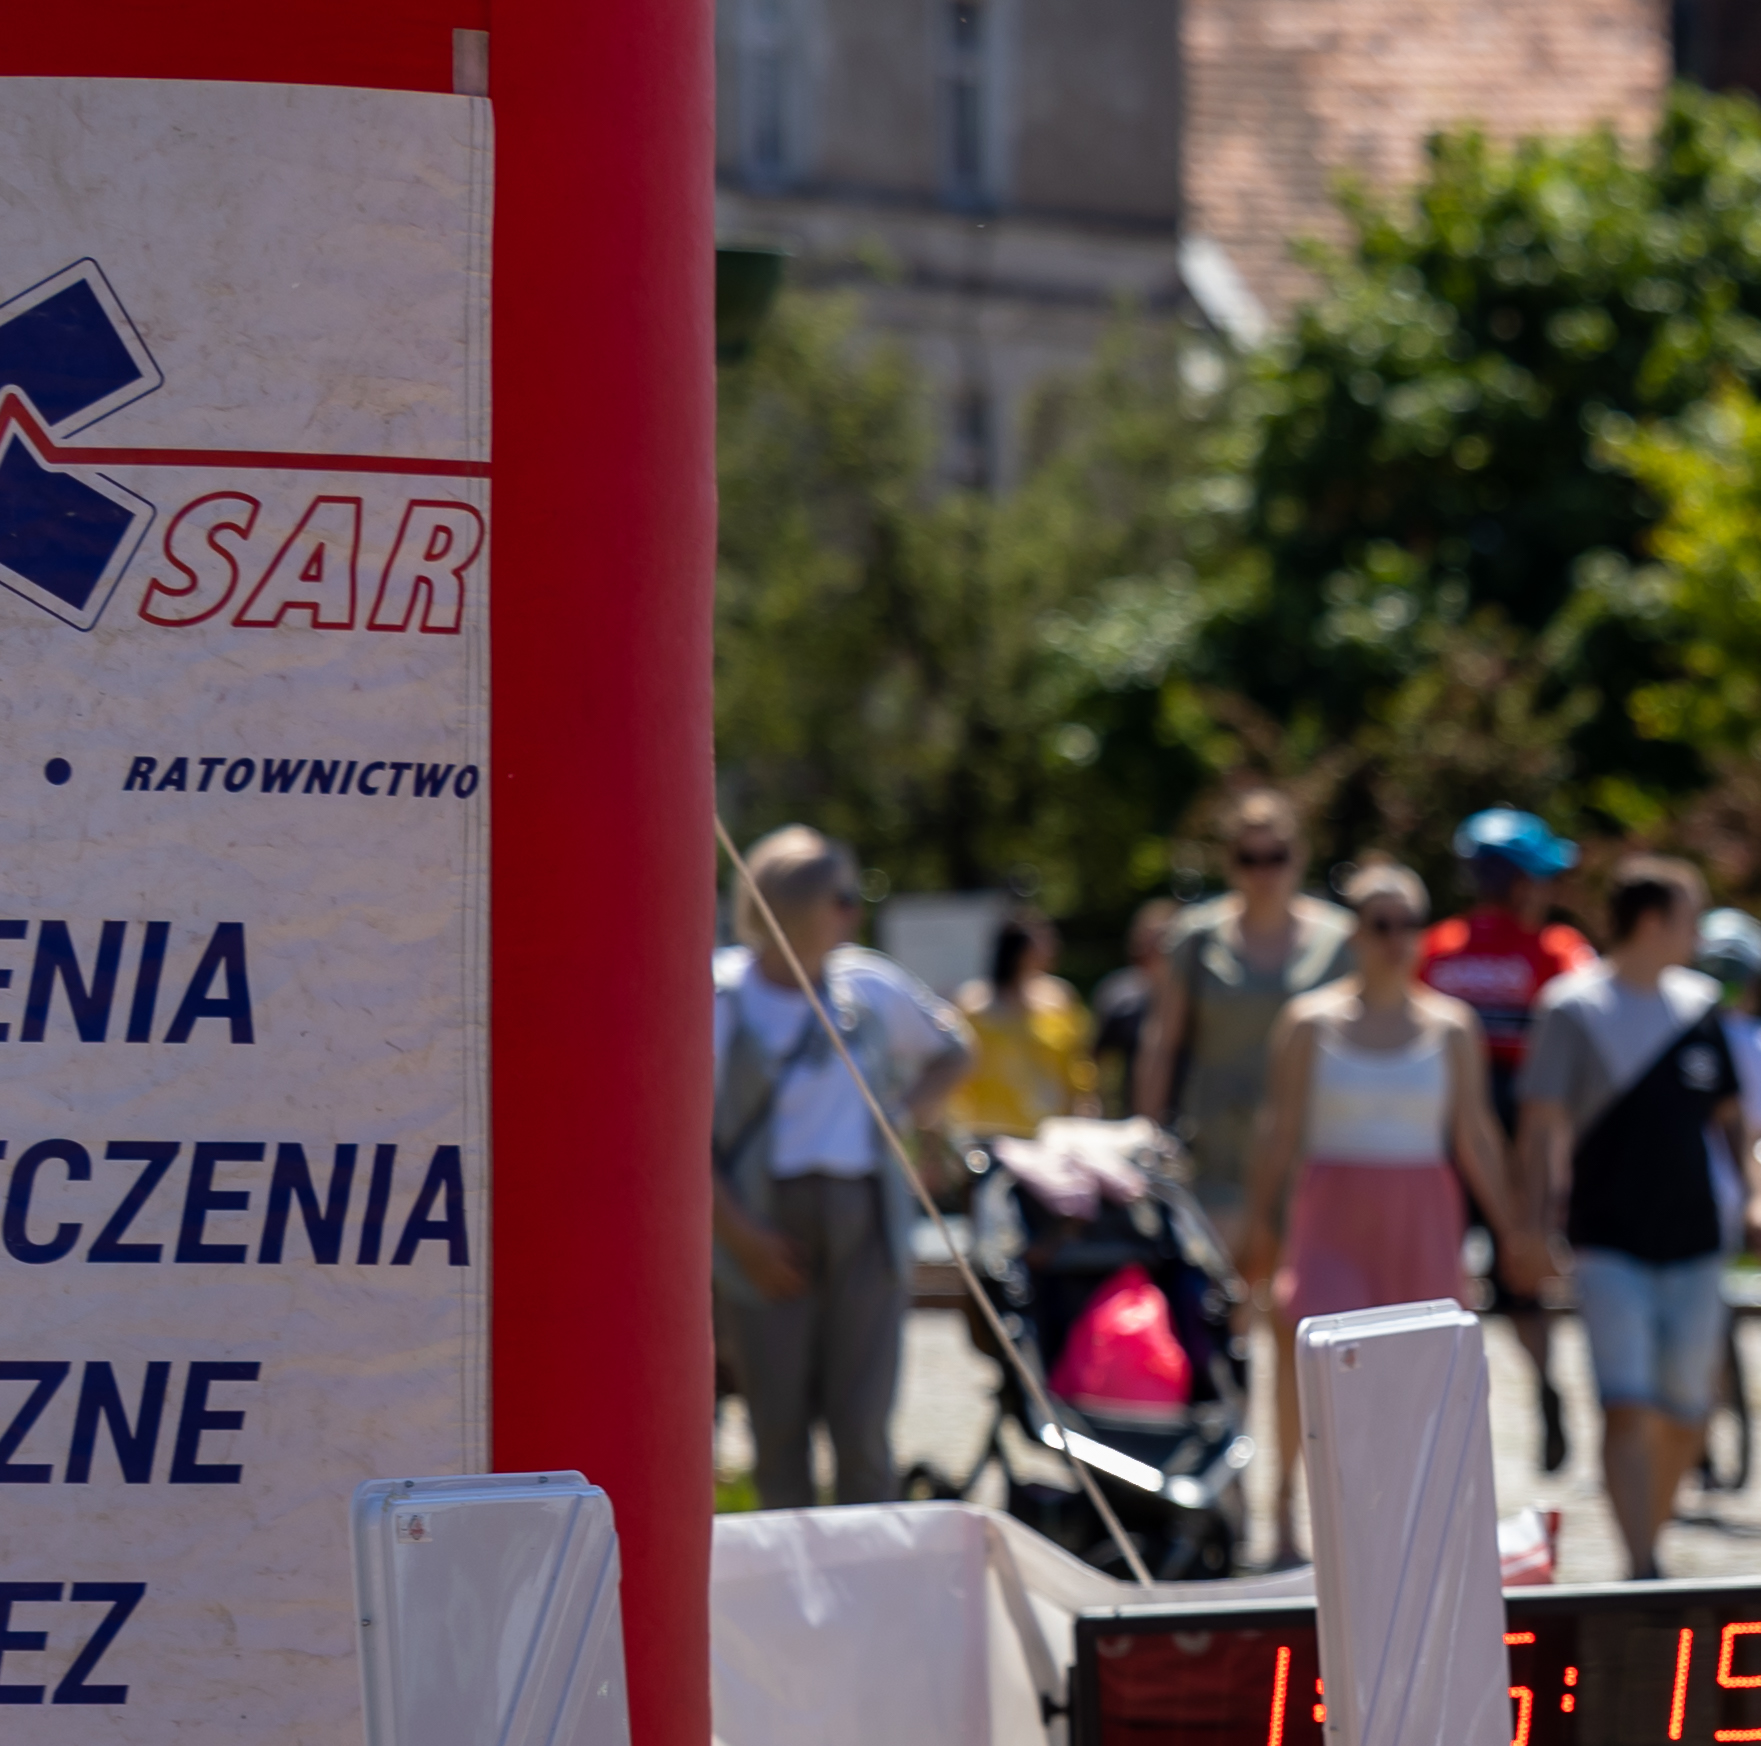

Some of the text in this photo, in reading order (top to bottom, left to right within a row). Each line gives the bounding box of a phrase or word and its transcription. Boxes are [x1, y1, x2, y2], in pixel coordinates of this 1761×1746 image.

[138, 490, 487, 636] SAR
[122, 754, 481, 801] RATOWNICTWO
[0, 1137, 471, 1267] CZENIA
